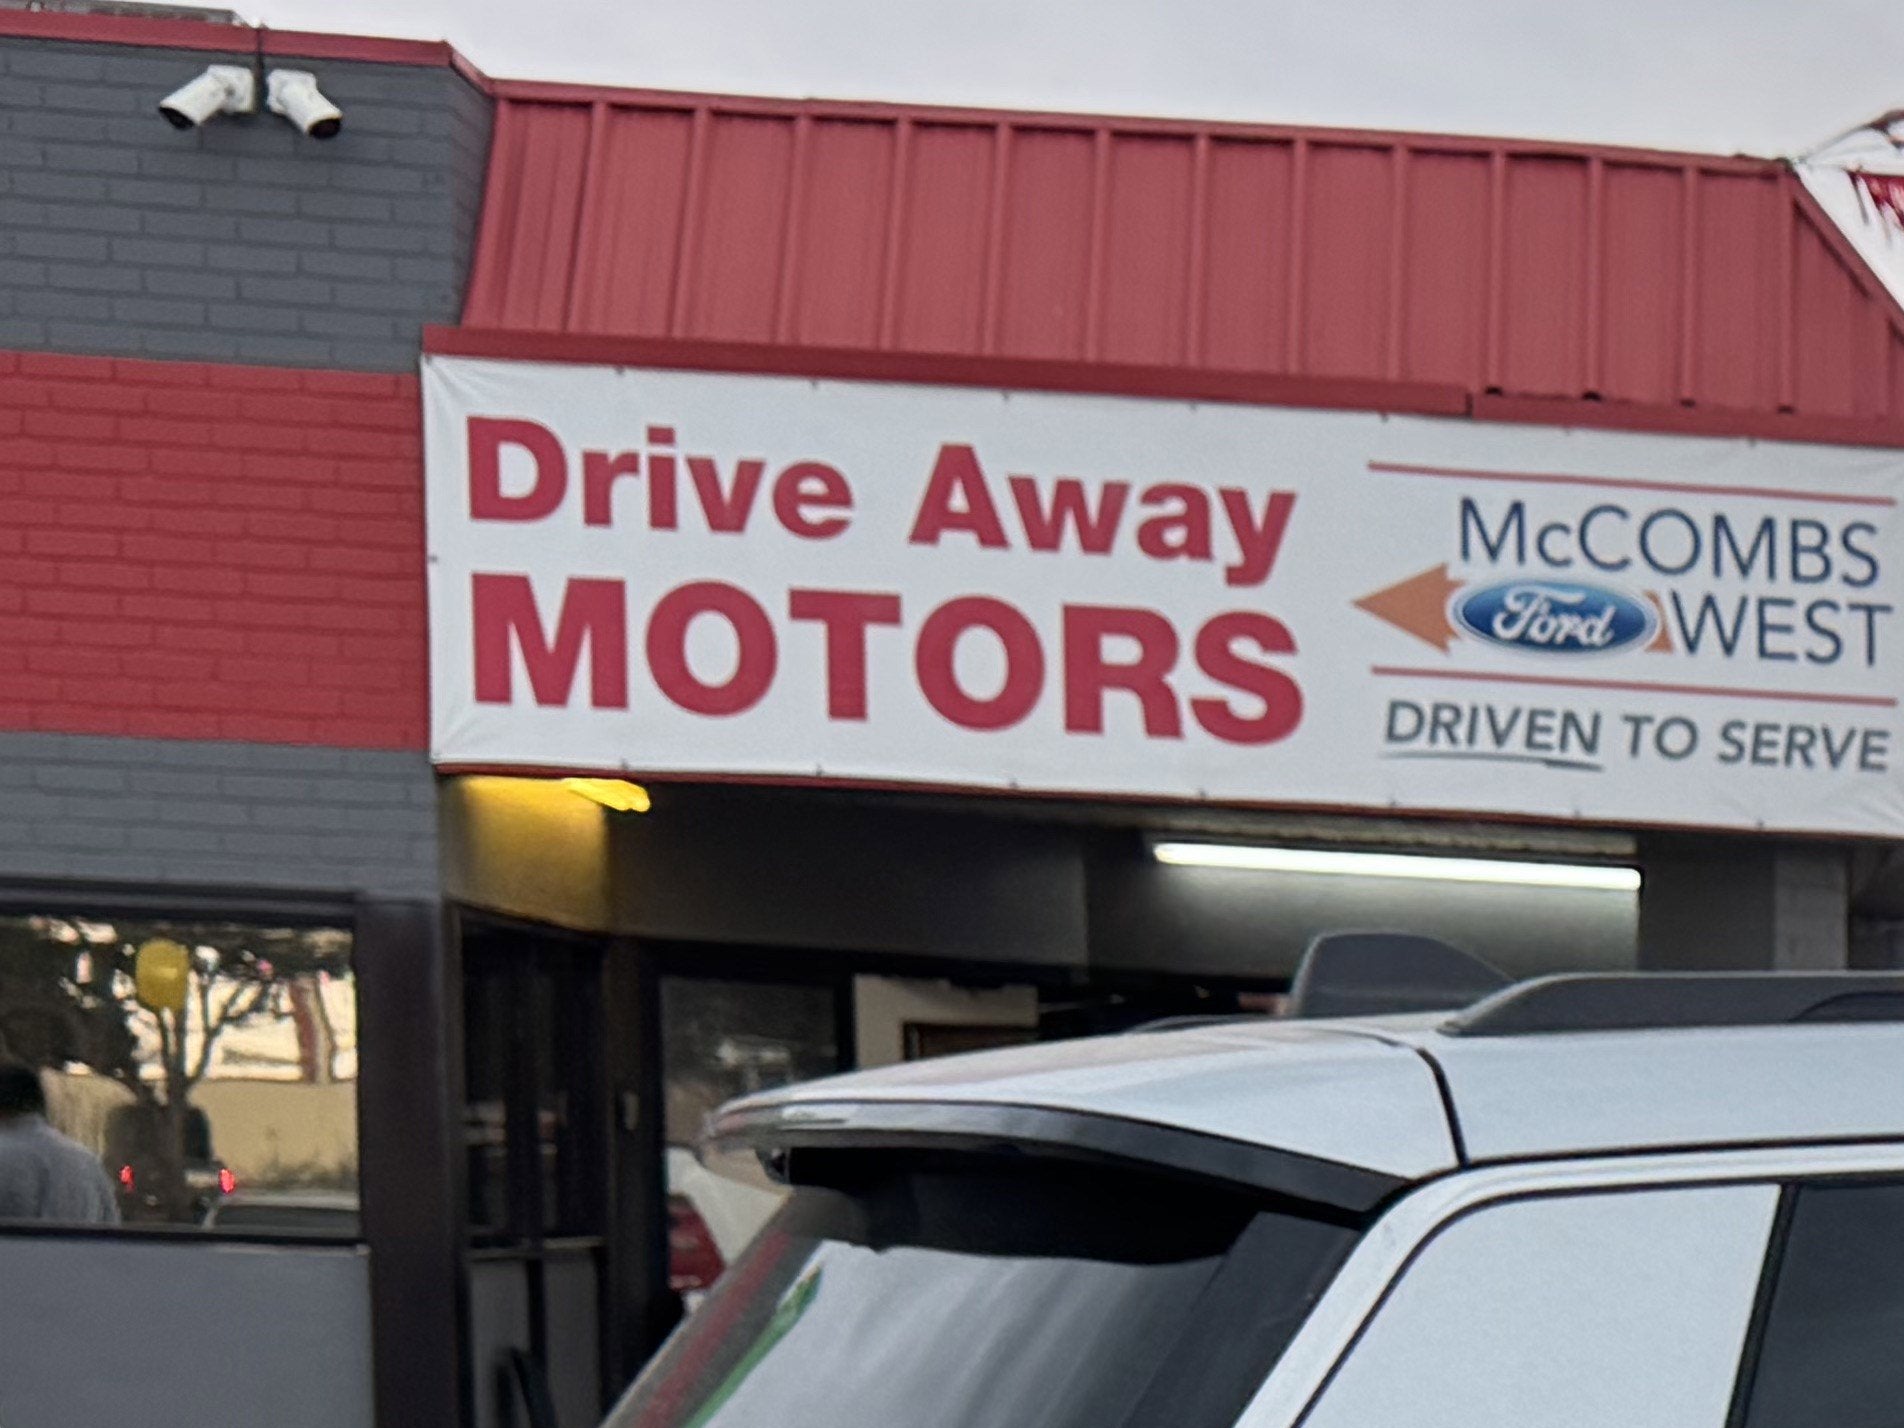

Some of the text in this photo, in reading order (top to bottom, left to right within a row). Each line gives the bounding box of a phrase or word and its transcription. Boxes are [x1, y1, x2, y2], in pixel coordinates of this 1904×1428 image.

[466, 415, 1297, 588] Drive Away
[1459, 496, 1879, 589] McCOMBS
[471, 572, 1305, 747] MOTORS
[1492, 584, 1893, 667] Ford WEST
[1385, 699, 1892, 773] DRIVEN TO SERVE
